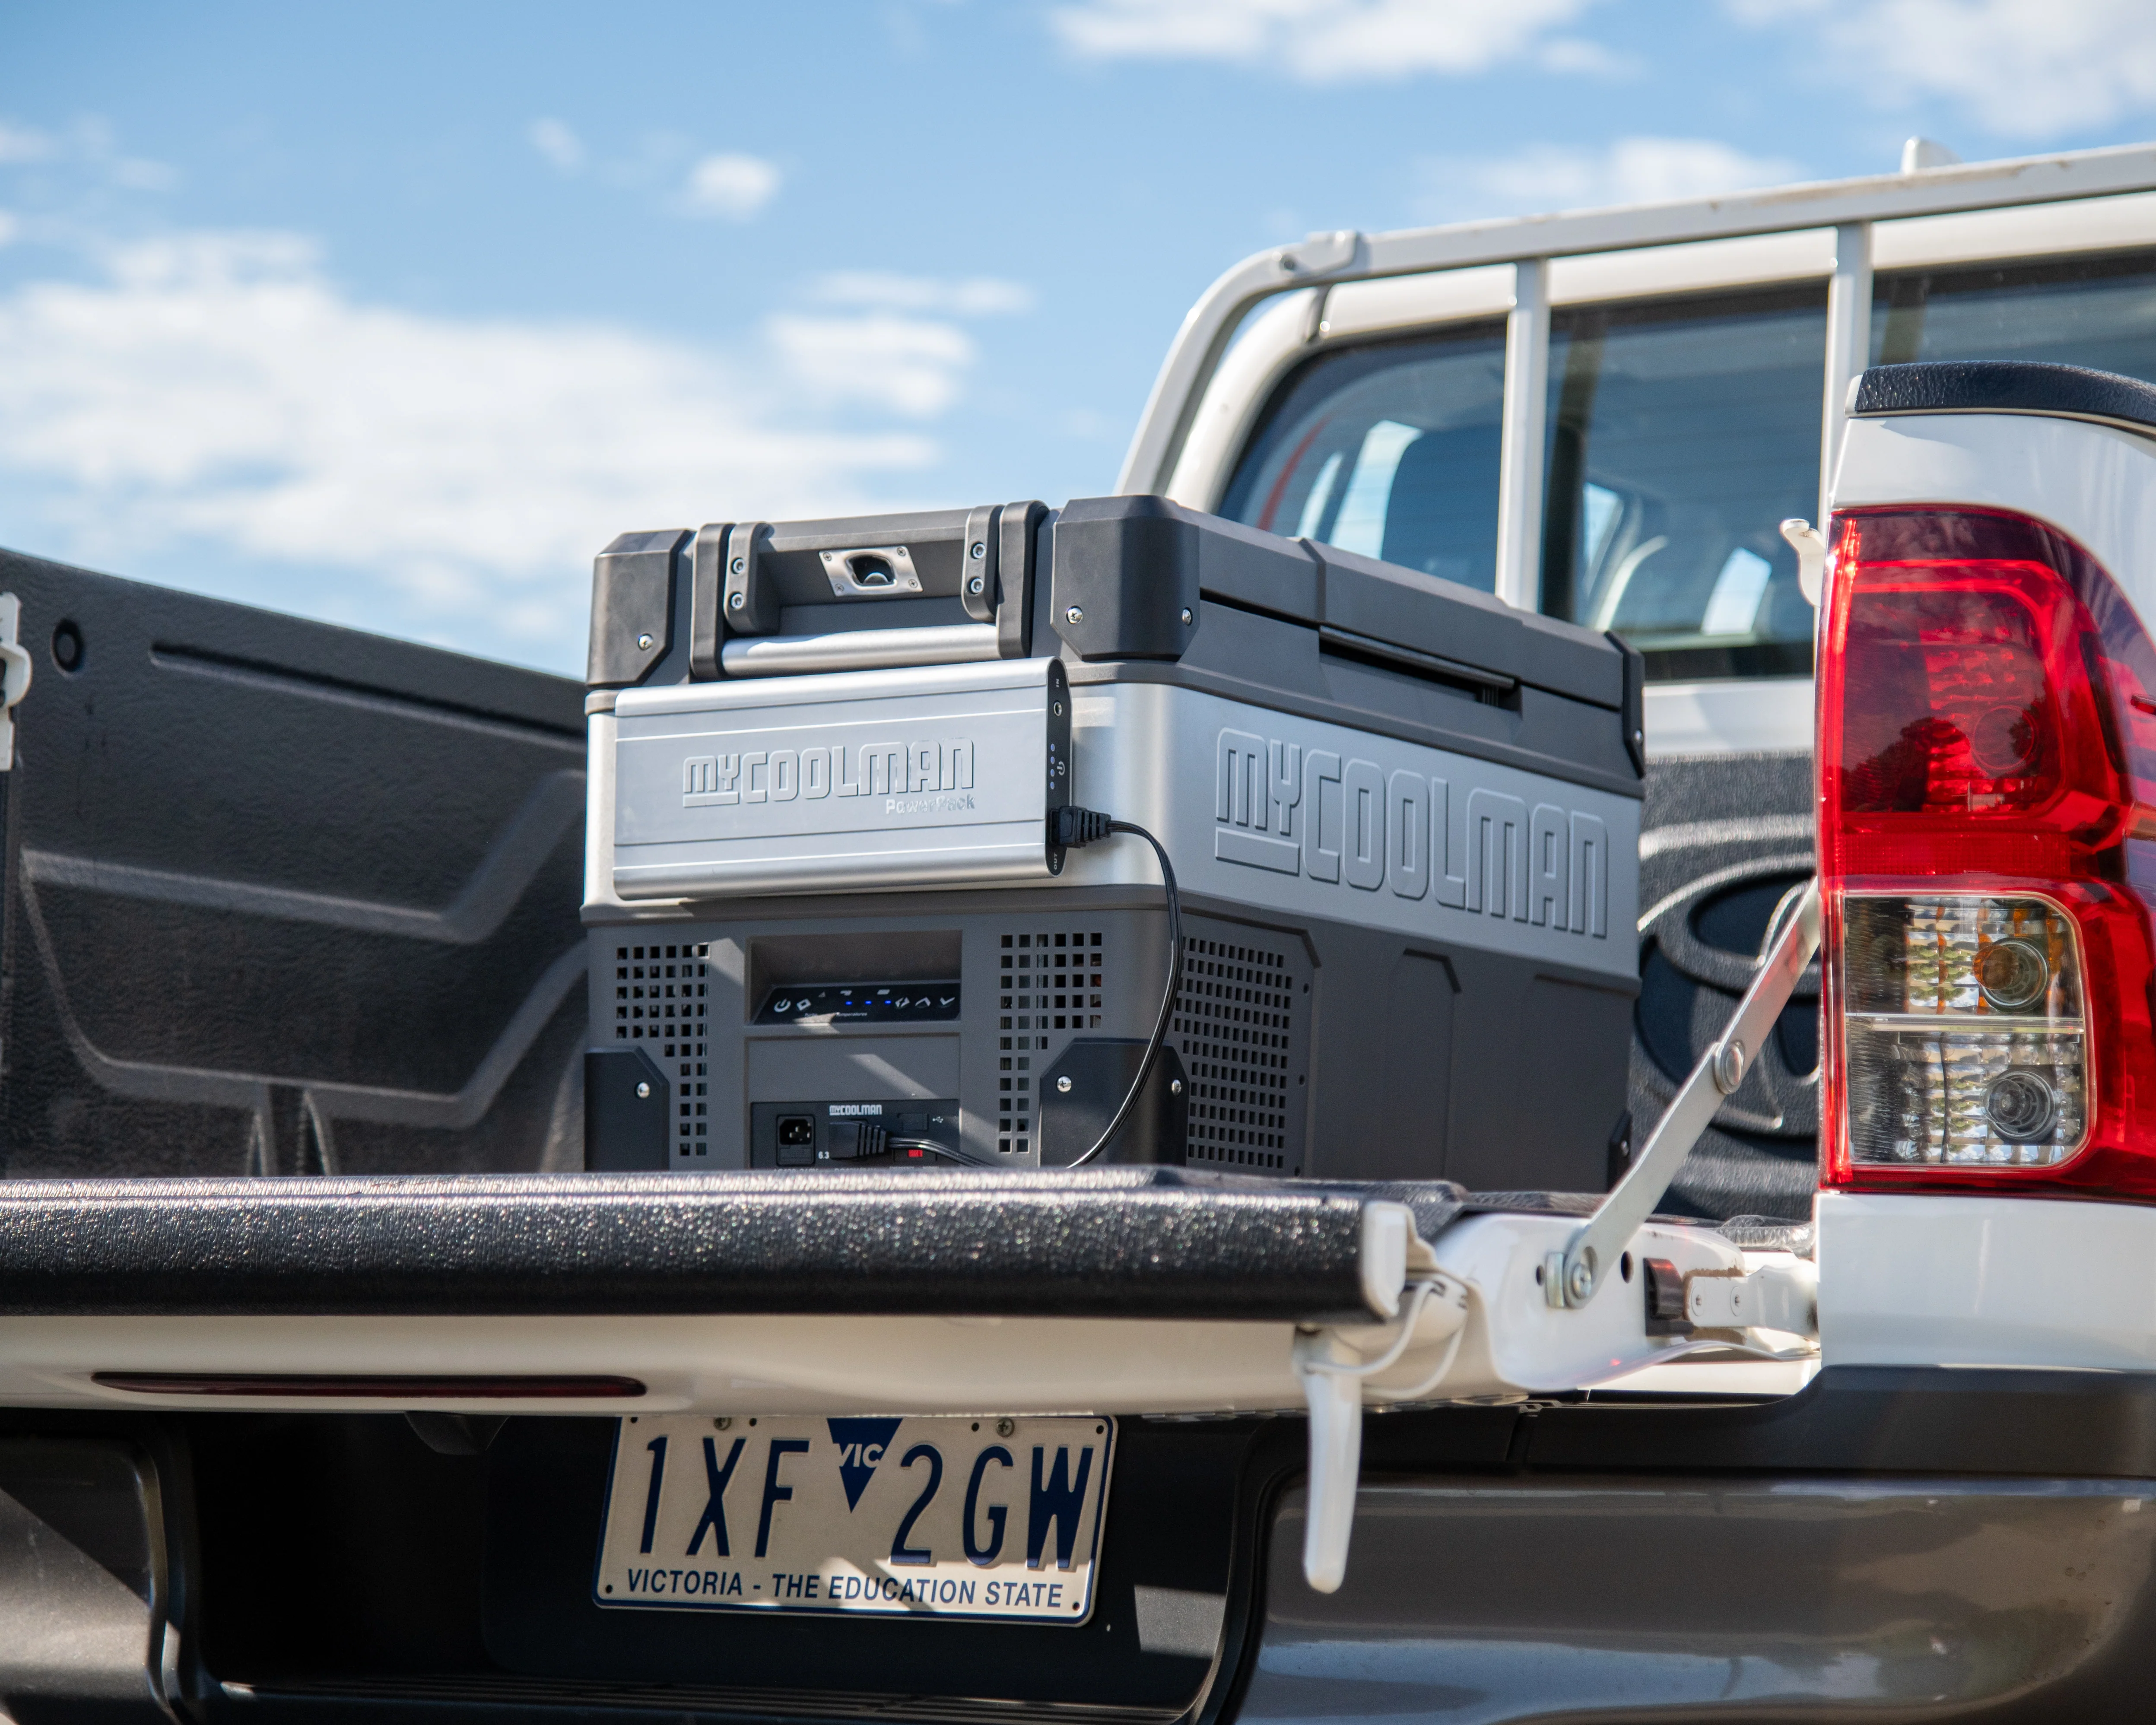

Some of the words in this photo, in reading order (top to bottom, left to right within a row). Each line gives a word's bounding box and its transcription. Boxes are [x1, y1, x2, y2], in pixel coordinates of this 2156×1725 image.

[1056, 679, 1060, 687] IN
[683, 737, 974, 807] MYCOOLMAN
[886, 794, 975, 814] PowerPack
[1215, 727, 1608, 938] MYCOOLMAN
[829, 1104, 882, 1115] MYCOOLMAN
[833, 1443, 883, 1468] VIC
[640, 1435, 809, 1558] 1XF
[890, 1444, 1094, 1568] 2GW
[628, 1569, 742, 1595] VICTORIA
[772, 1573, 819, 1598] THE
[829, 1576, 976, 1604] EDUCATION
[985, 1581, 1063, 1607] STATE
